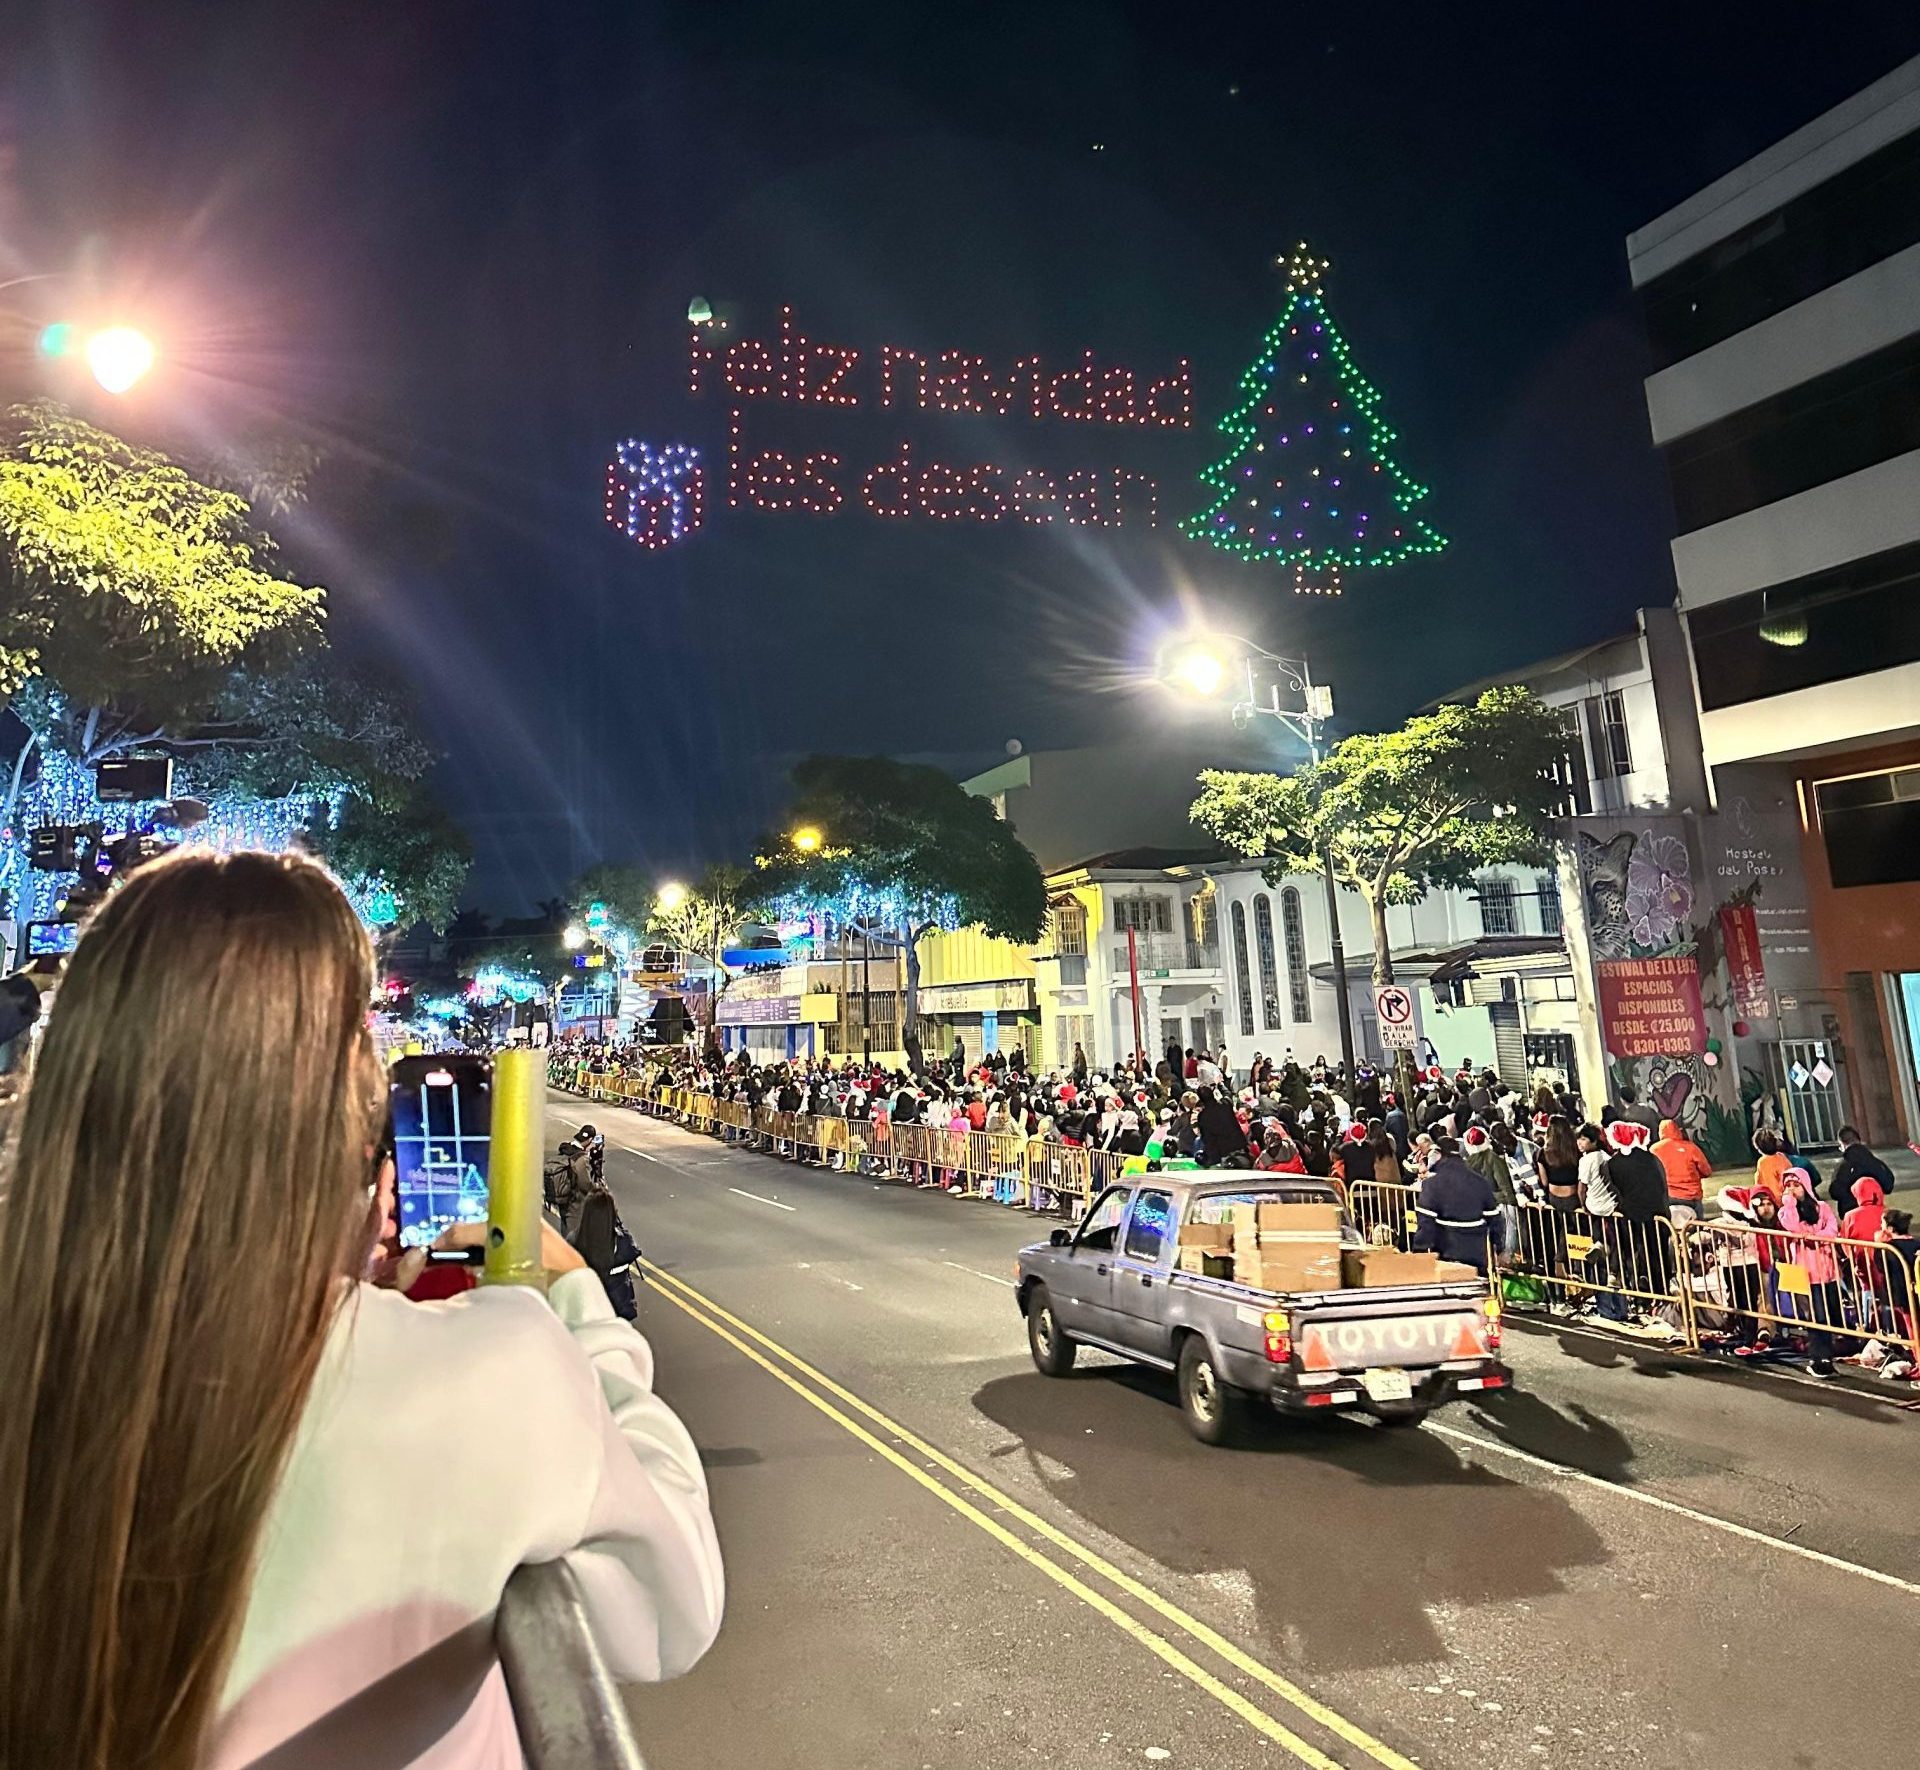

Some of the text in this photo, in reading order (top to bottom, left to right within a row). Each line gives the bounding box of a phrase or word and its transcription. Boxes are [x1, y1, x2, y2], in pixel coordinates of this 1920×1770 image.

[729, 409, 1156, 527] les desean
[1597, 961, 1646, 978] FESTIVAL
[1645, 960, 1662, 976] DE
[1662, 959, 1677, 975] LA
[1623, 980, 1674, 996] ESPACIOS
[1617, 998, 1686, 1015] DISPONIBLES
[1612, 1020, 1650, 1036] DESDE:
[1633, 1036, 1692, 1055] 8301-0303
